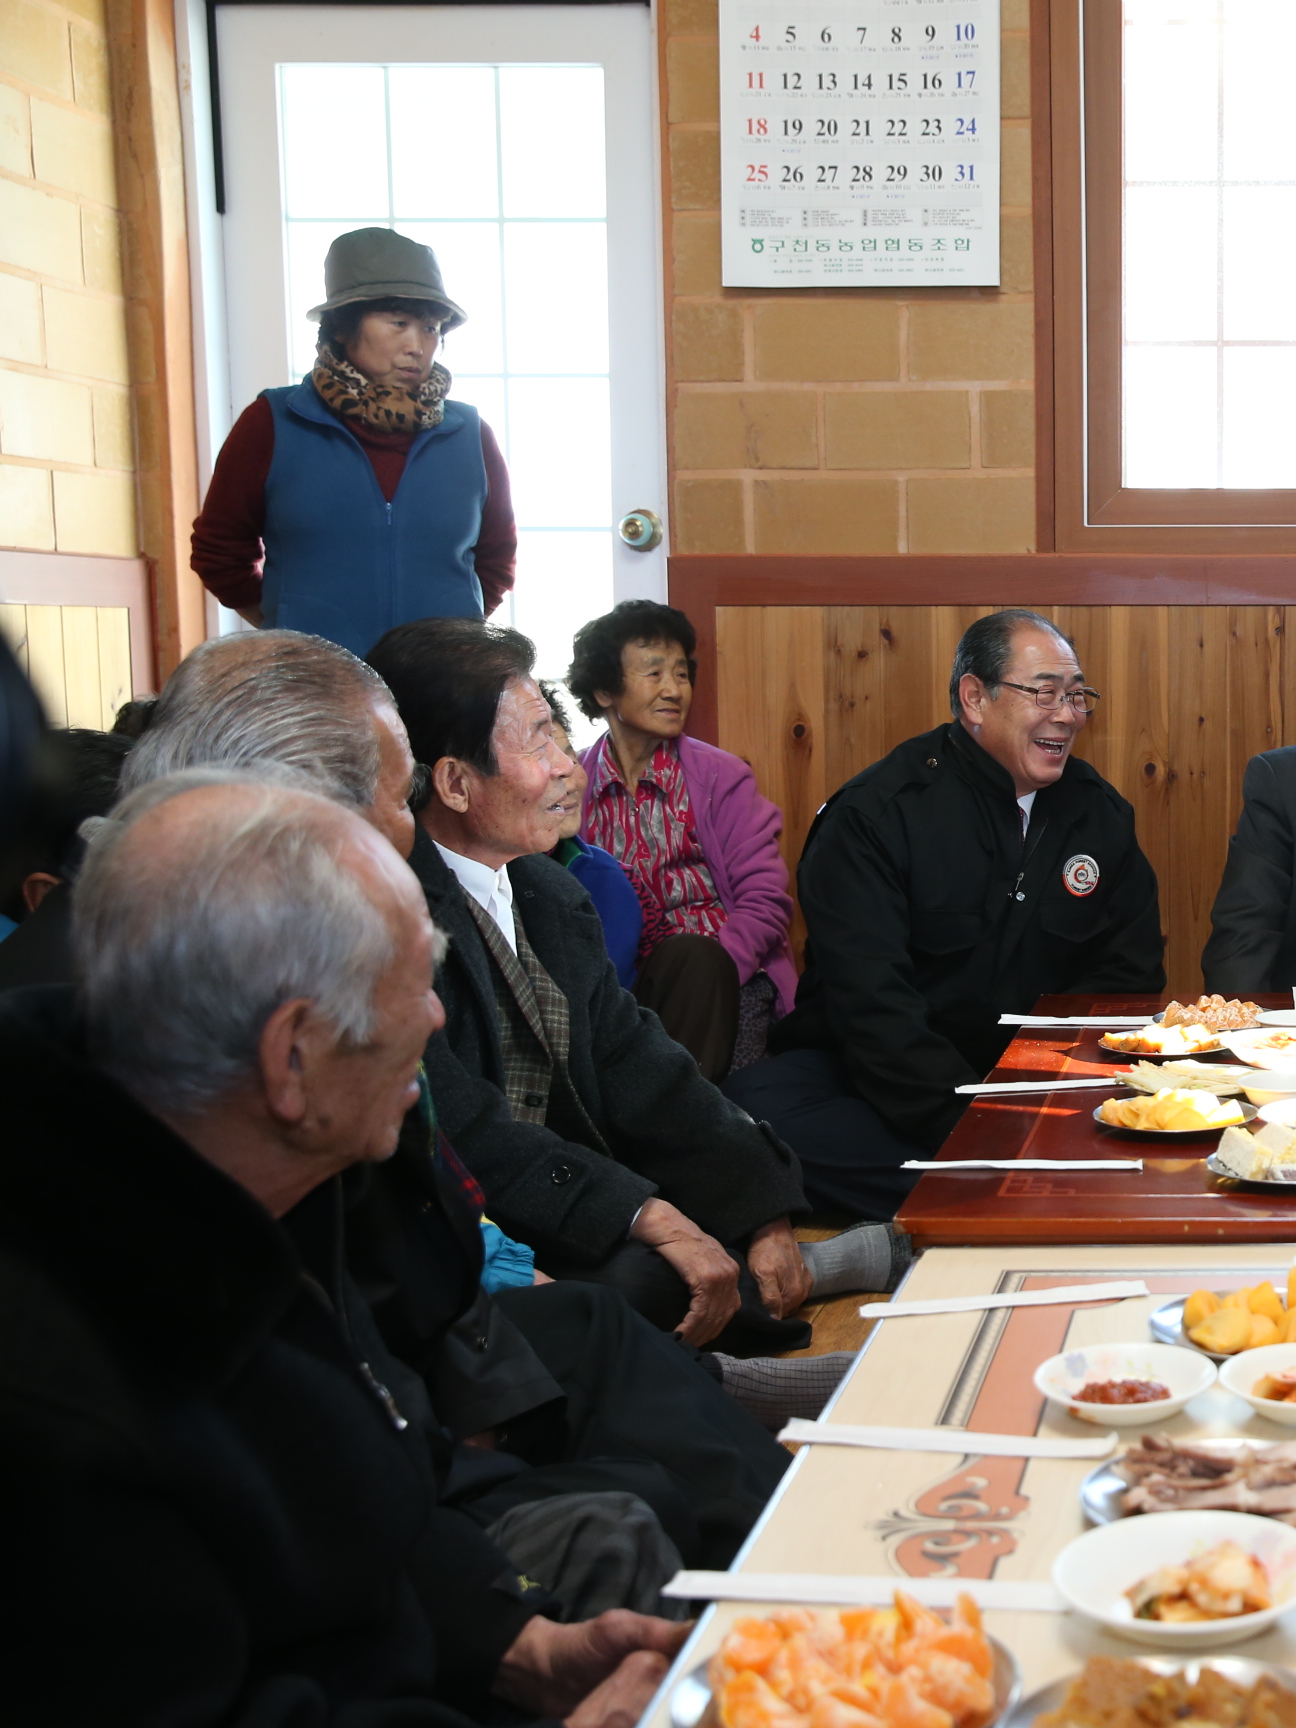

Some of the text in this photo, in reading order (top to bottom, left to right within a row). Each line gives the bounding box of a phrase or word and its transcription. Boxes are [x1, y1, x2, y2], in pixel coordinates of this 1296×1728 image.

[749, 23, 976, 44] 4 5 6 7 8 9 10
[747, 70, 977, 91] 11 12 13 14 15 16 17
[746, 117, 977, 137] 18 19 20 21 22 23 24
[746, 164, 976, 183] 25 26 27 28 29 30 31
[768, 238, 972, 253] 구천동농업협동조합
